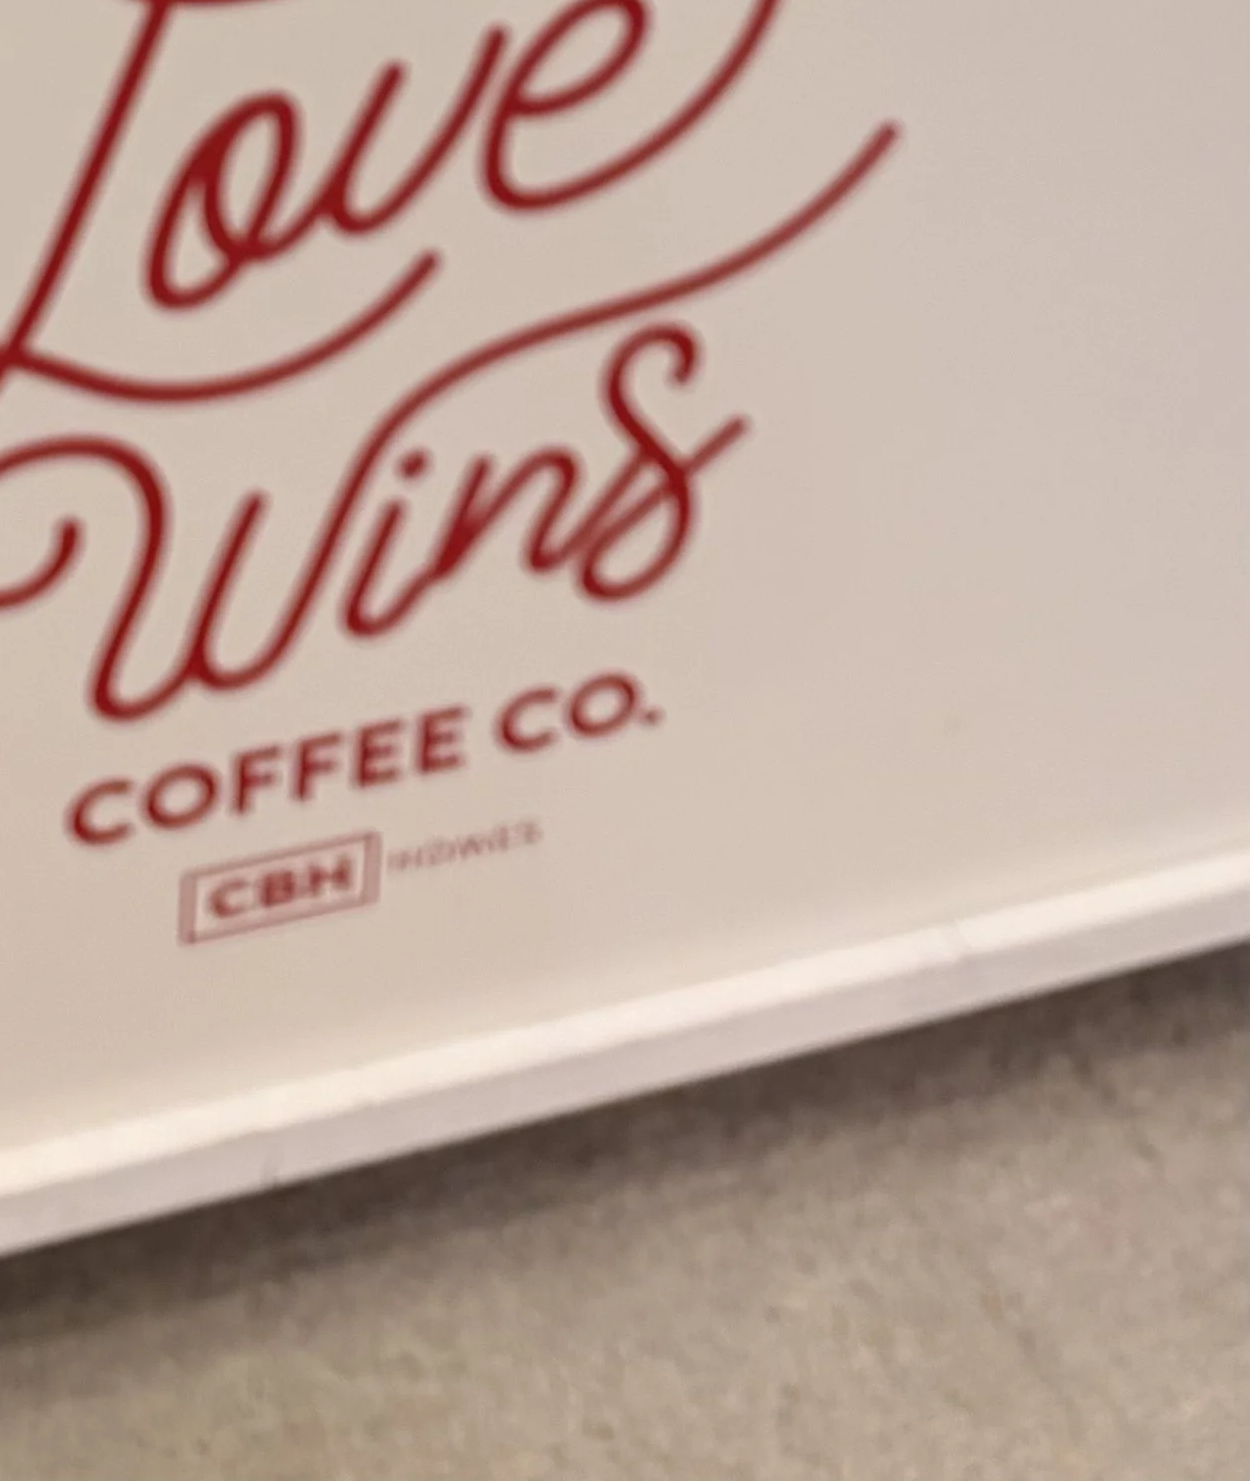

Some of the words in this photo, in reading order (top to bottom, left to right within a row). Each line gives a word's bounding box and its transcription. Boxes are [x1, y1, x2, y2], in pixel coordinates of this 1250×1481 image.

[65, 704, 470, 847] COFFEE
[493, 671, 664, 755] CO.
[207, 855, 354, 920] CBH
